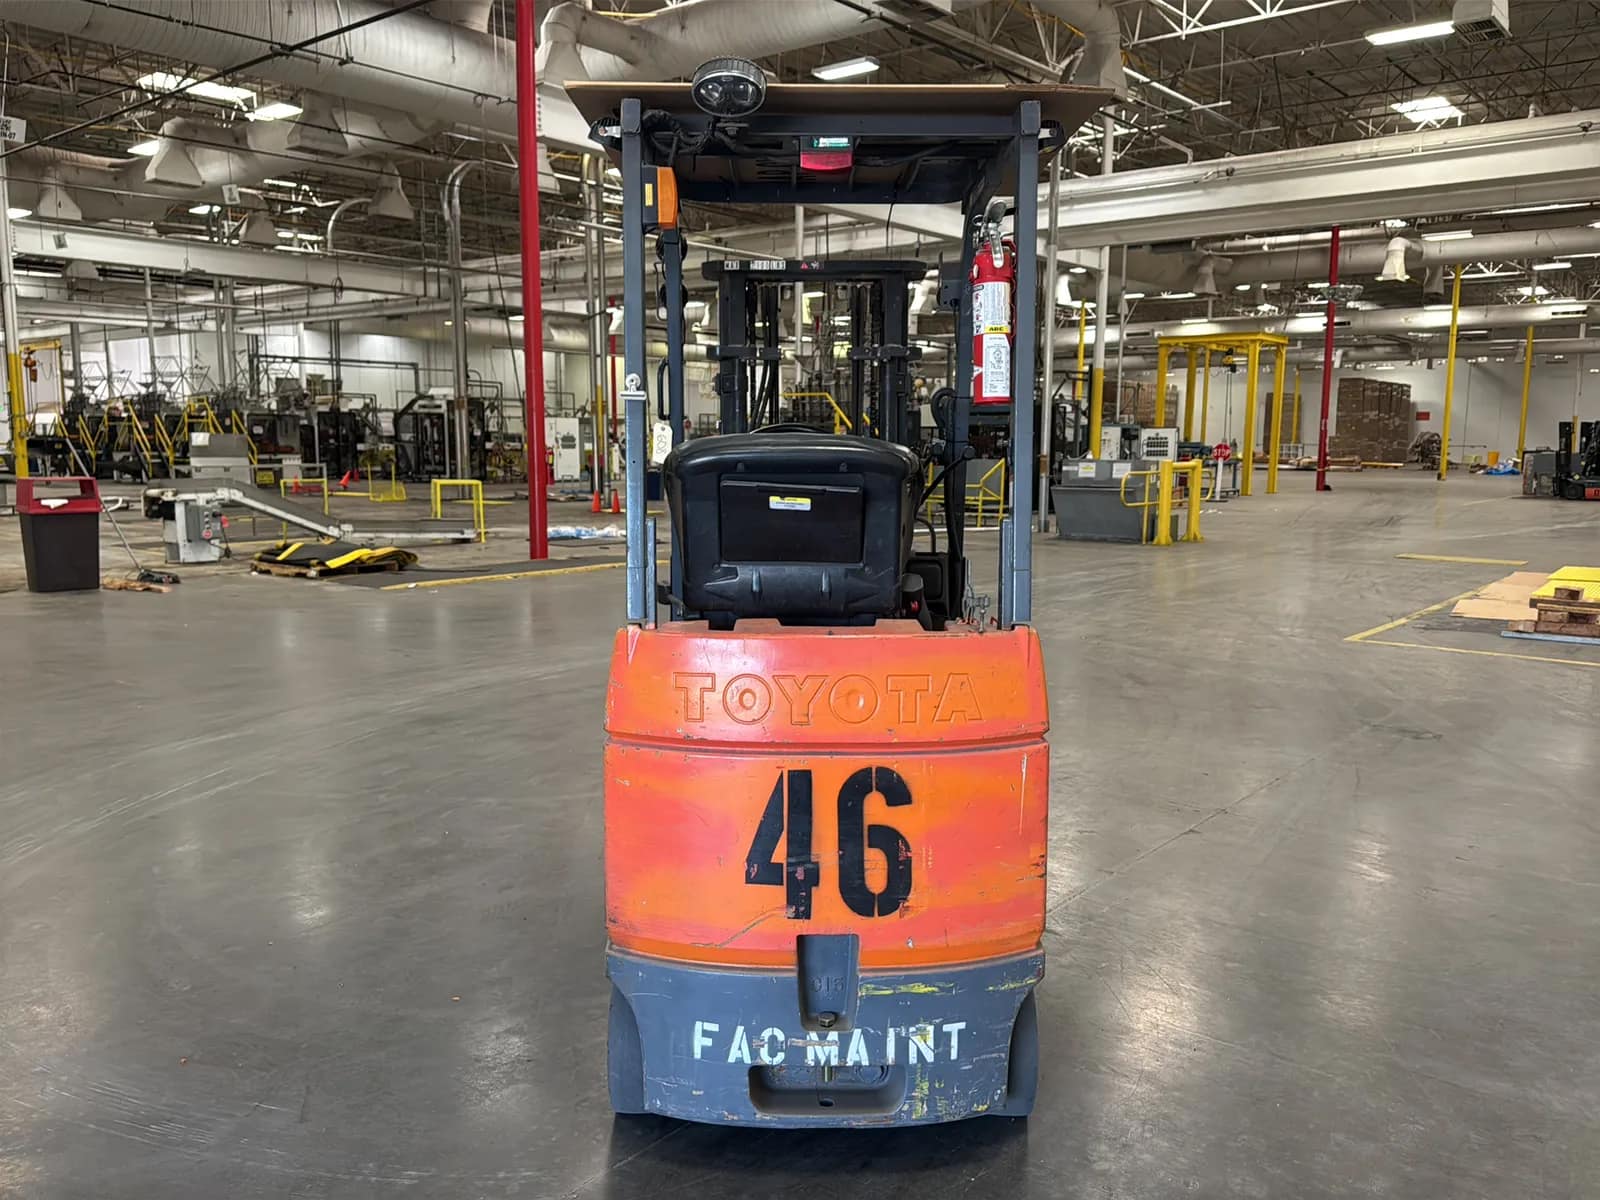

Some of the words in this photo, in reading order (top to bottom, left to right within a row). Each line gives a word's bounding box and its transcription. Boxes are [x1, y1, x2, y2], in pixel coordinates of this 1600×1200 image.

[1213, 448, 1231, 457] STOP
[673, 671, 984, 726] TOYOTA
[745, 766, 912, 920] 46
[693, 1020, 785, 1065] FAC
[806, 1021, 967, 1066] MAINT
